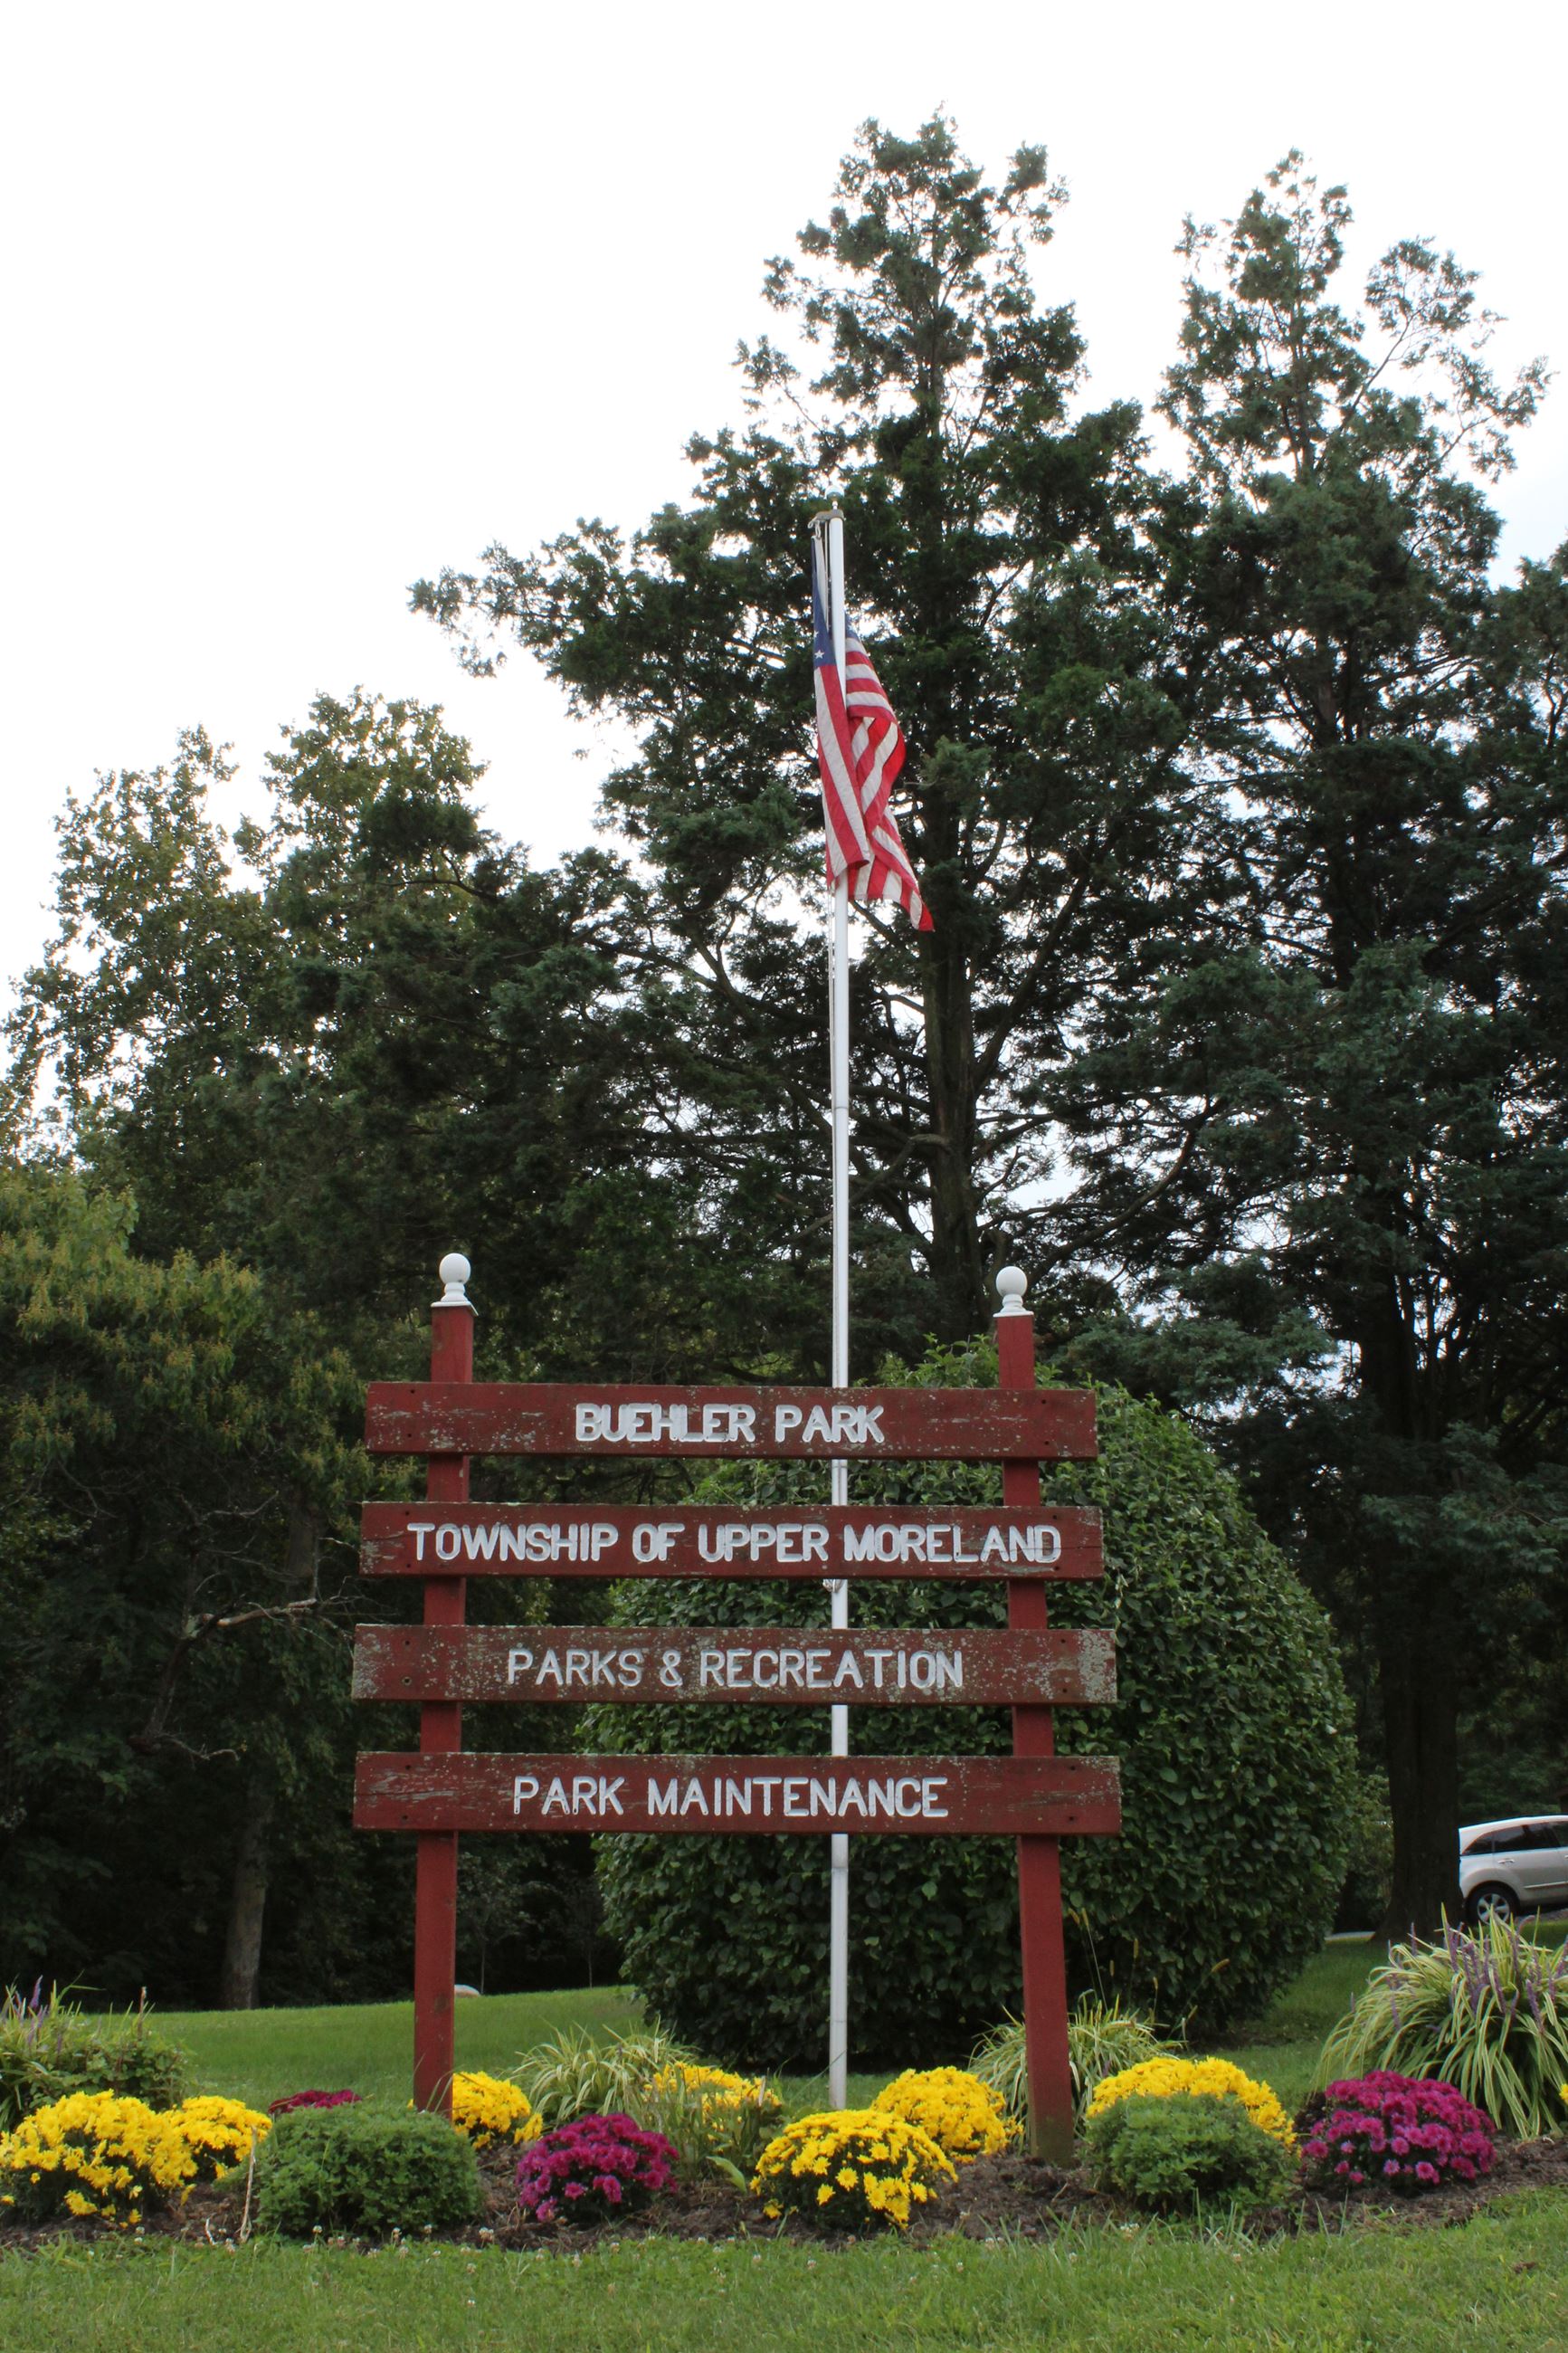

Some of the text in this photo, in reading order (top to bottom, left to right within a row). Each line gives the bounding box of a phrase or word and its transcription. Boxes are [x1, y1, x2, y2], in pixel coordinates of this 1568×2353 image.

[575, 1403, 885, 1443] BUEHLER PARK
[407, 1522, 1061, 1564] TOWNSHIP OF UPPER MORELAND
[508, 1648, 964, 1689] PARKS & RECREATION
[514, 1777, 948, 1817] PARK MAINTENANCE
